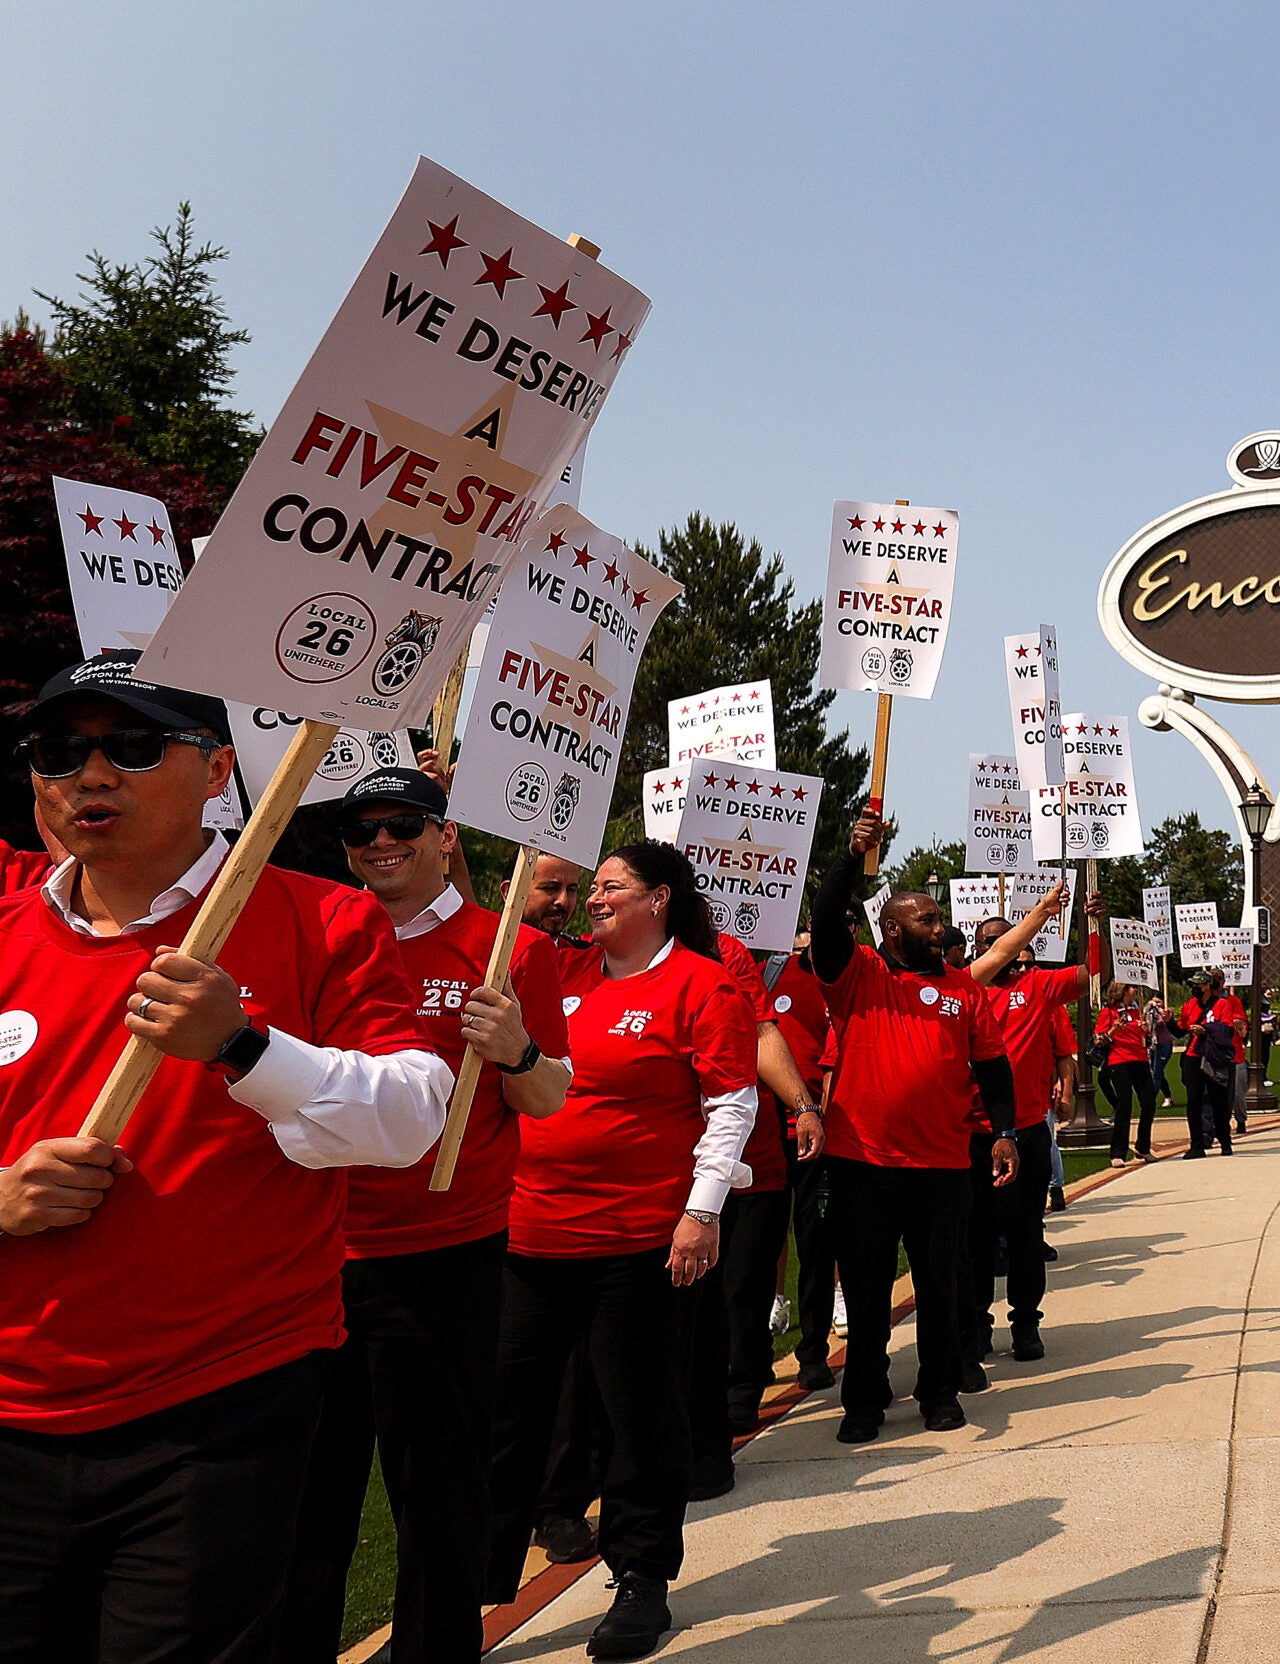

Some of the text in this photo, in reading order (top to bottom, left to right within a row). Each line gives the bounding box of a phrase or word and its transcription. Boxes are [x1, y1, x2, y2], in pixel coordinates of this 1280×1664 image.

[382, 272, 606, 422] WE DESERVE
[464, 407, 502, 449] A
[291, 410, 537, 544] FIVE-STAR
[262, 493, 502, 603] CONTRACT
[842, 539, 947, 564] WE DESERVE
[80, 551, 126, 583] WE
[887, 569, 899, 584] A
[528, 563, 639, 654] WE DESERVE
[838, 590, 943, 619] FIVE-STAR
[307, 603, 367, 631] LOCAL
[296, 621, 354, 656] 26
[838, 619, 939, 644] CONTRACT
[285, 649, 345, 672] UNITEHERE!
[578, 640, 594, 667] A
[70, 662, 135, 679] Encor
[869, 659, 879, 669] 26
[1046, 657, 1056, 671] WE
[1015, 665, 1038, 679] WE
[498, 650, 621, 739] FIVE-STAR
[355, 695, 400, 710] LOCAL 25
[678, 704, 764, 729] WE DESERVE
[715, 725, 723, 734] A
[333, 739, 353, 748] CAL
[490, 701, 612, 777] CONTRACT
[1064, 742, 1122, 756] DESERVE
[325, 749, 353, 766] 26
[1080, 761, 1089, 773] A
[518, 770, 545, 785] LOCAL
[975, 777, 1020, 790] WE DESE
[515, 781, 541, 803] 26
[1002, 794, 1009, 805] A
[652, 800, 673, 815] WE
[696, 794, 721, 813] WE
[726, 800, 807, 826] DESERVE
[1041, 803, 1127, 817] CONTRACT
[544, 828, 559, 840] LOCAL
[738, 827, 751, 842] A
[1070, 832, 1083, 840] 26
[685, 845, 797, 876] FIVE-STAR
[695, 873, 792, 899] ONTRACT
[957, 897, 970, 905] WE
[716, 913, 723, 922] 6
[423, 979, 468, 989] LOCAL
[423, 989, 462, 1008] 26
[941, 995, 962, 1006] LOCAL
[624, 1010, 652, 1019] LOCAL
[942, 1001, 959, 1015] 26
[615, 1017, 646, 1032] 26
